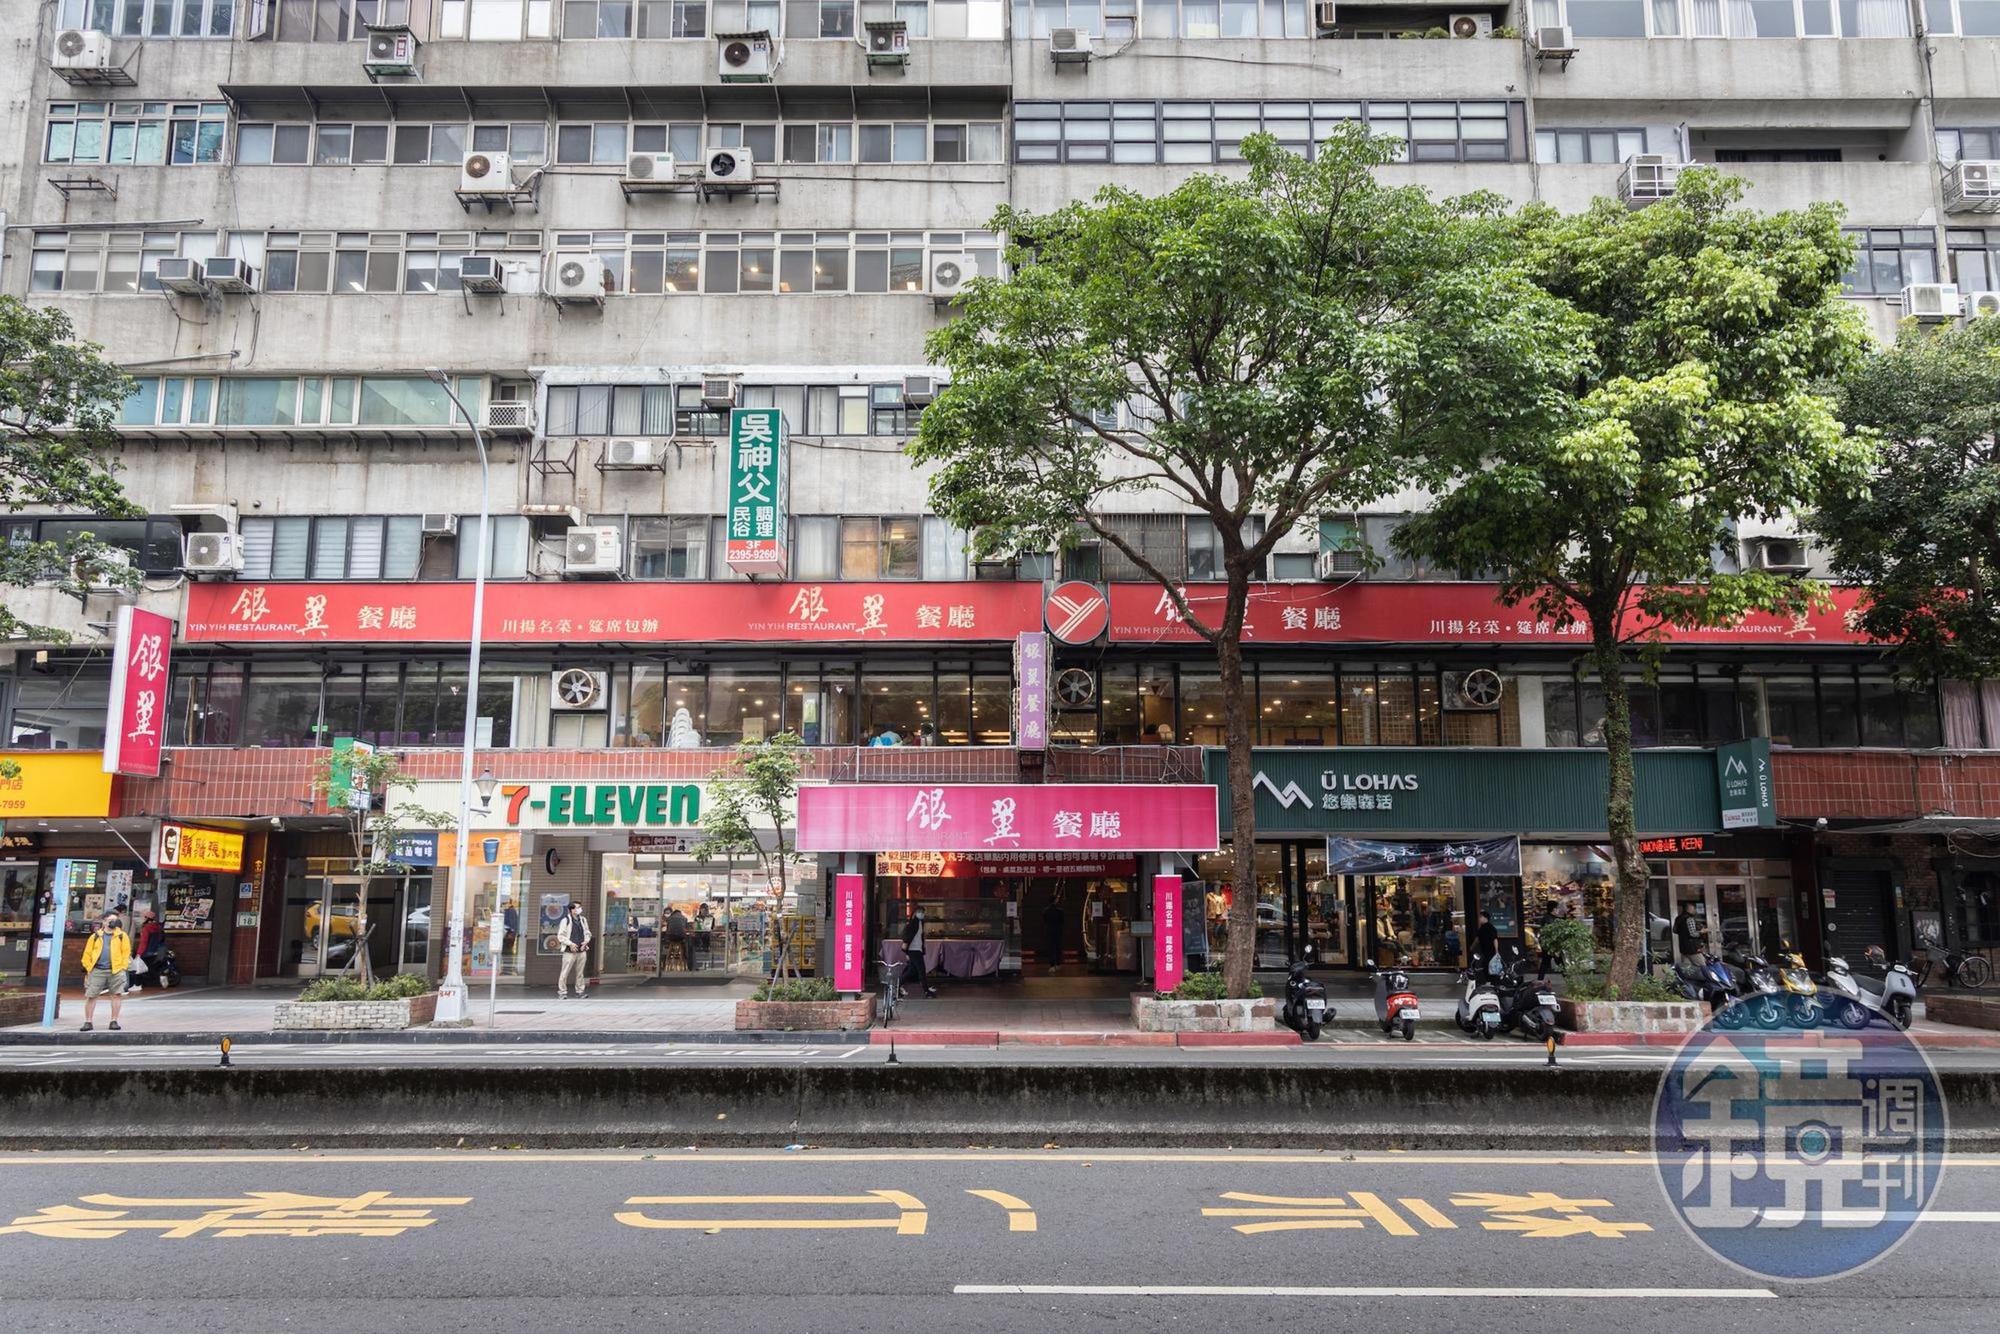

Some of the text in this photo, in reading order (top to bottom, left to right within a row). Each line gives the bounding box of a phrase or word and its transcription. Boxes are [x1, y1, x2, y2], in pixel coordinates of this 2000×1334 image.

[738, 413, 773, 503] 吳神父
[732, 506, 751, 538] 民俗
[755, 506, 774, 537] 調理
[729, 549, 776, 561] 2395-9260
[745, 540, 762, 550] 3F
[230, 586, 417, 637] 銀翼 餐廳
[748, 622, 857, 631] YIN YIH RESTAURANT
[788, 586, 976, 637] 銀翼 餐廳
[1281, 606, 1342, 630] 餐廳
[189, 623, 298, 632] YIN YIH RESTAURANT
[1113, 626, 1131, 634] YIN
[1133, 626, 1151, 634] YIH
[128, 633, 165, 746] 銀翼
[1023, 642, 1043, 740] 銀翼餐廳
[1344, 774, 1419, 791] LOHAS
[907, 788, 1121, 848] 銀翼 餐廳
